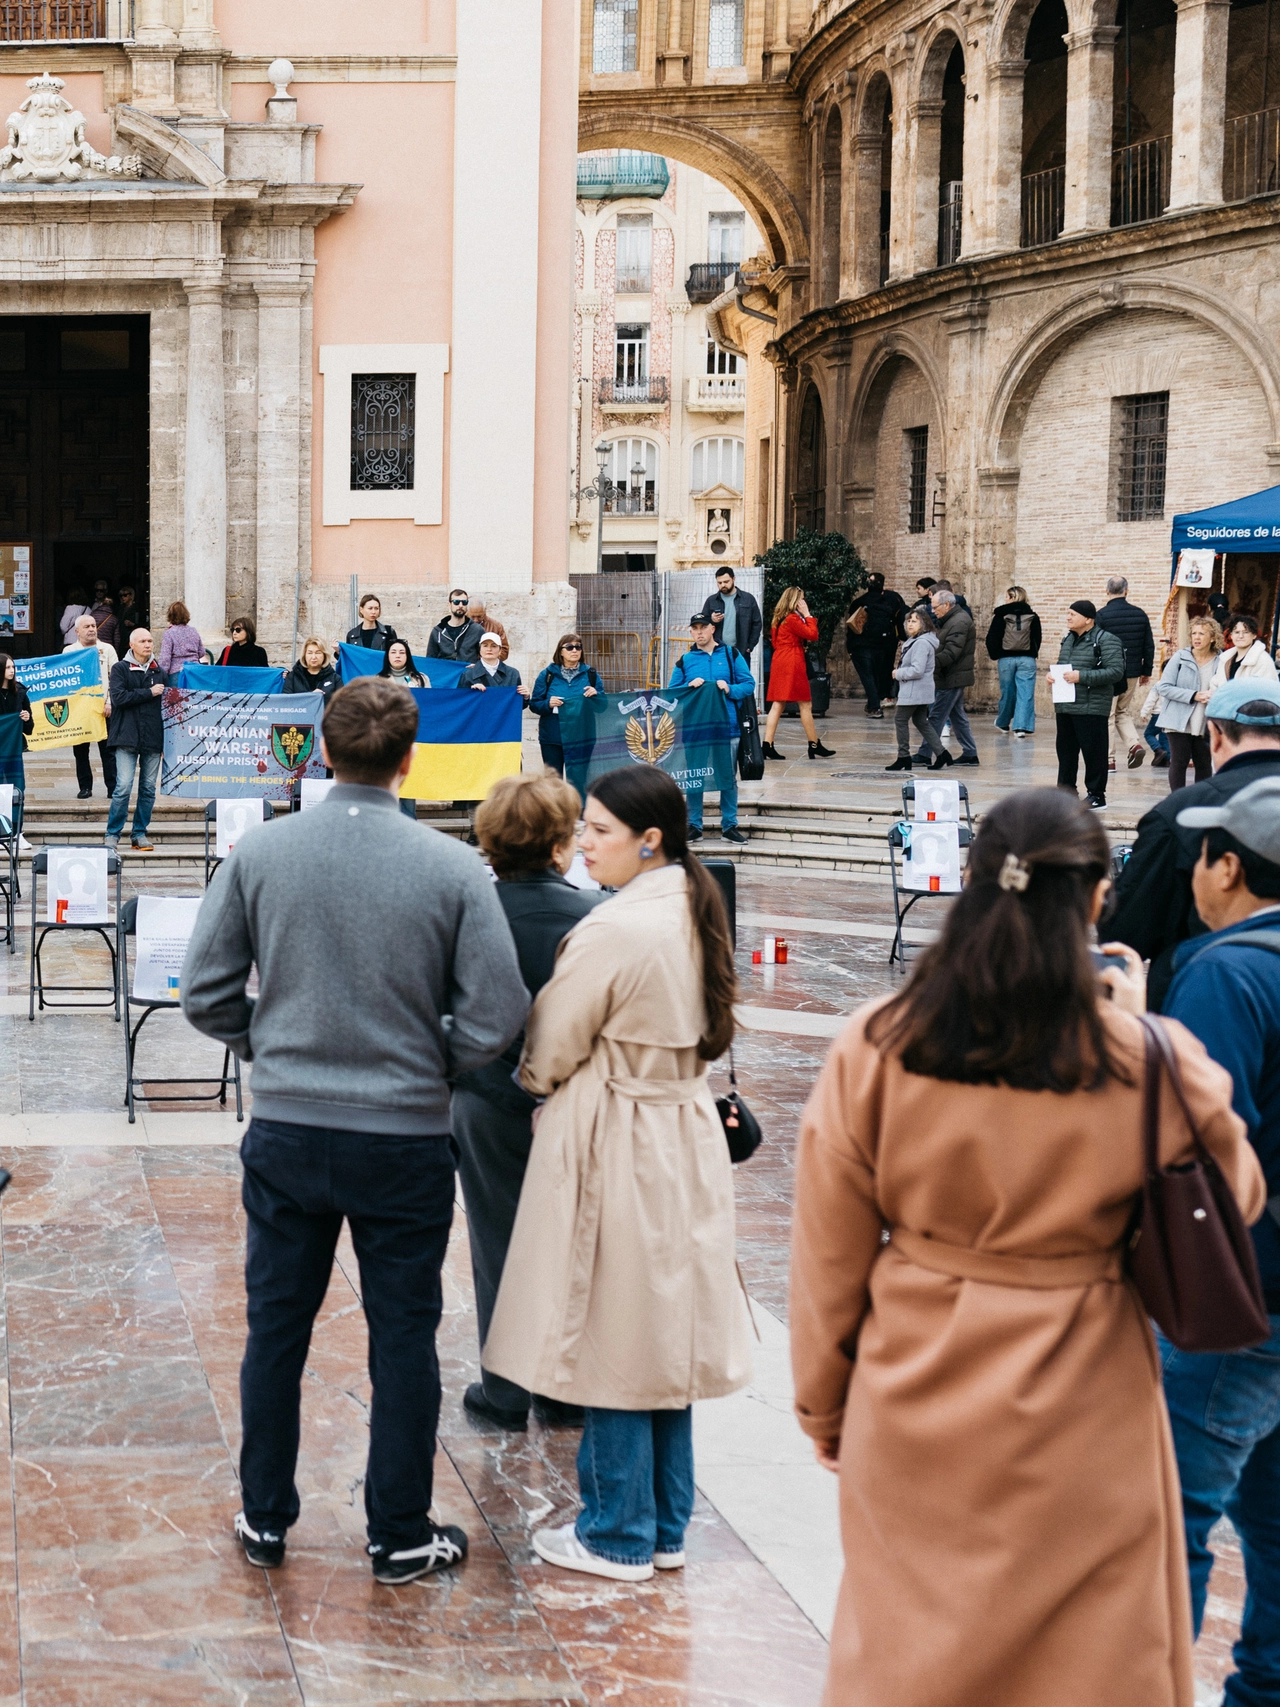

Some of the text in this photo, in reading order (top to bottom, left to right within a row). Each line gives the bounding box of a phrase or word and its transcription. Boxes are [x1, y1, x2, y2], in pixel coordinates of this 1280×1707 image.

[1187, 526, 1250, 540] Seguidores
[1254, 526, 1269, 537] de
[16, 662, 46, 673] LEASE
[25, 665, 84, 681] HUSBANDS,
[50, 677, 80, 689] SONS!
[188, 726, 269, 739] UKRAINIAN
[204, 741, 268, 755] WARS in
[177, 756, 268, 766] RUSSIAN PRISON
